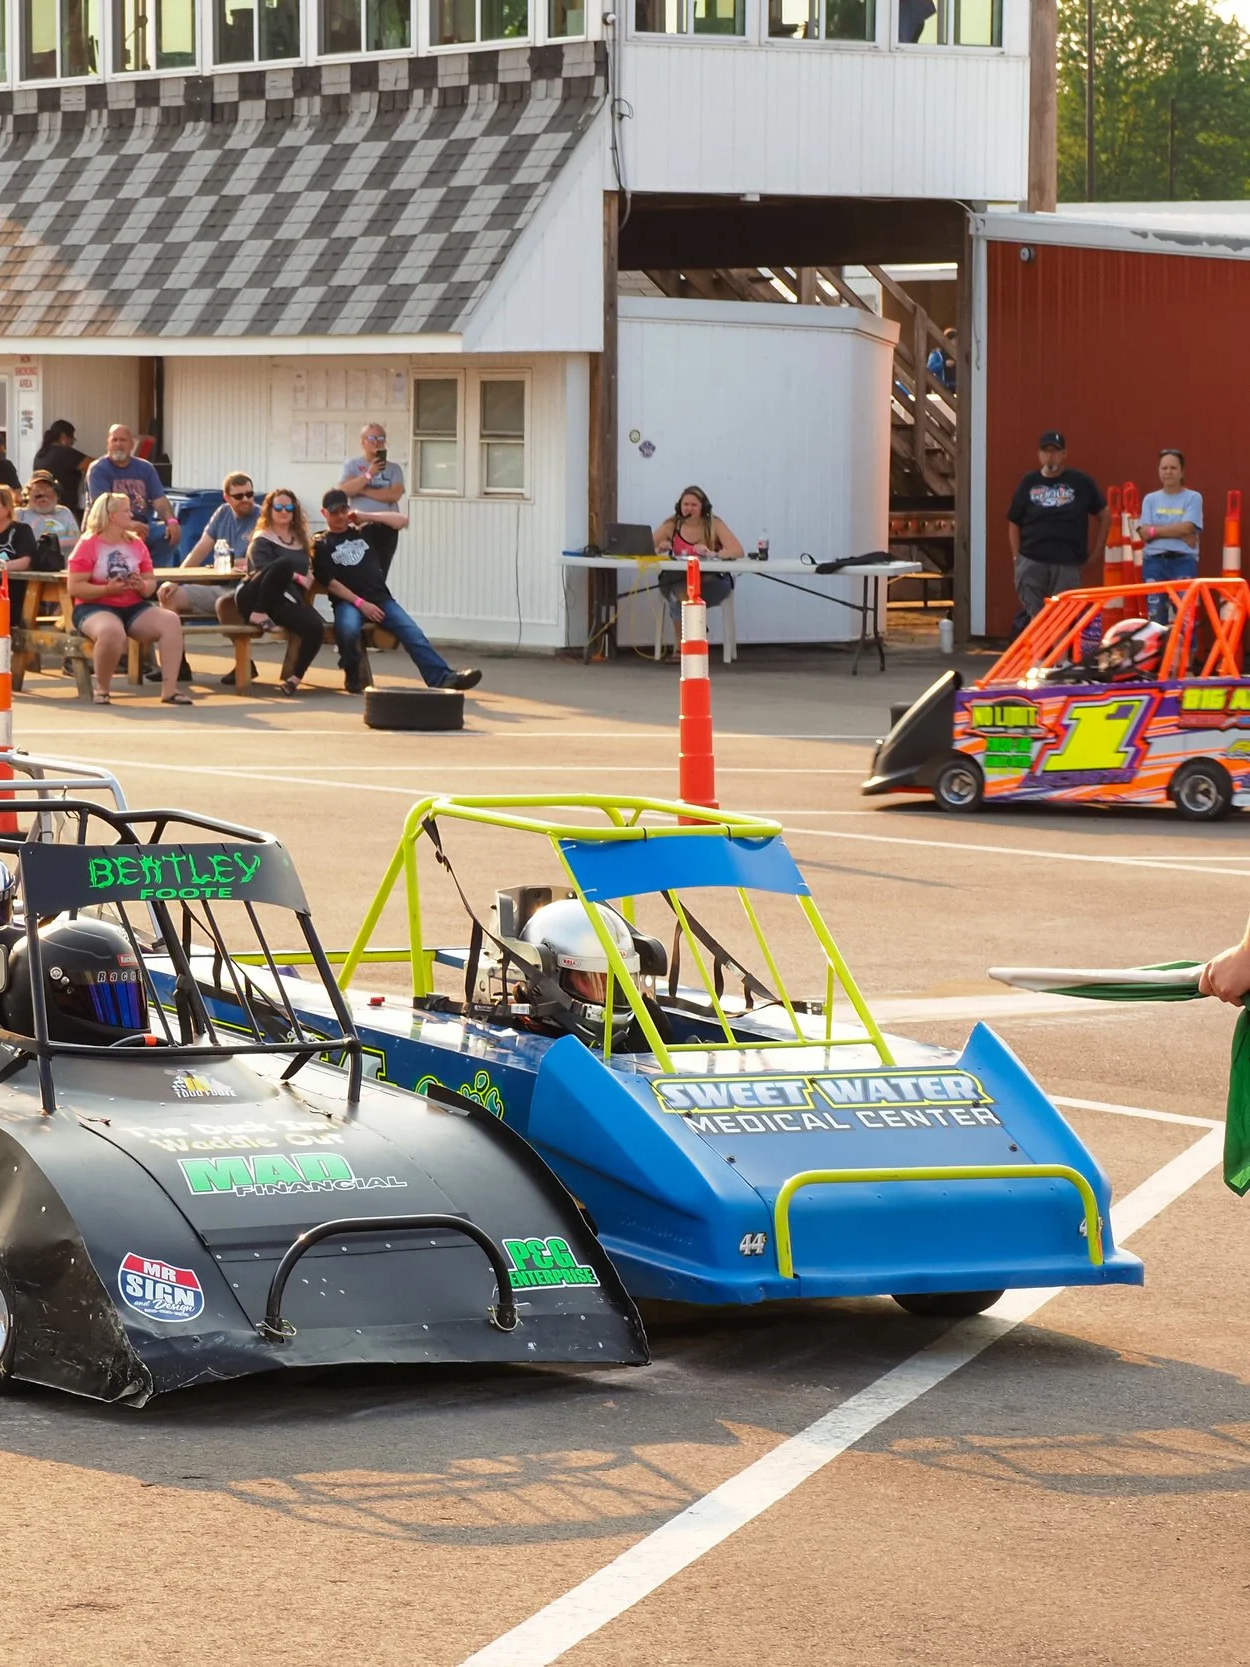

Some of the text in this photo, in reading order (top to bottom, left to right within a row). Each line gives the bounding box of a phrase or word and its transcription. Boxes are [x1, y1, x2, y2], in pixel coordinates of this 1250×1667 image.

[1042, 700, 1142, 772] 1
[88, 851, 262, 889] BENTLEY
[140, 887, 233, 900] FOOTE
[660, 1075, 981, 1109] SWEET WATER
[682, 1107, 1001, 1134] MEDICAL CENTER
[149, 1131, 346, 1152] Waddle Out
[177, 1152, 356, 1196] MAD
[235, 1176, 407, 1198] FINANCIAL
[143, 1261, 177, 1283] MR
[508, 1267, 598, 1289] ENTERPRISE
[126, 1273, 195, 1308] SIGN
[152, 1299, 196, 1314] Design
